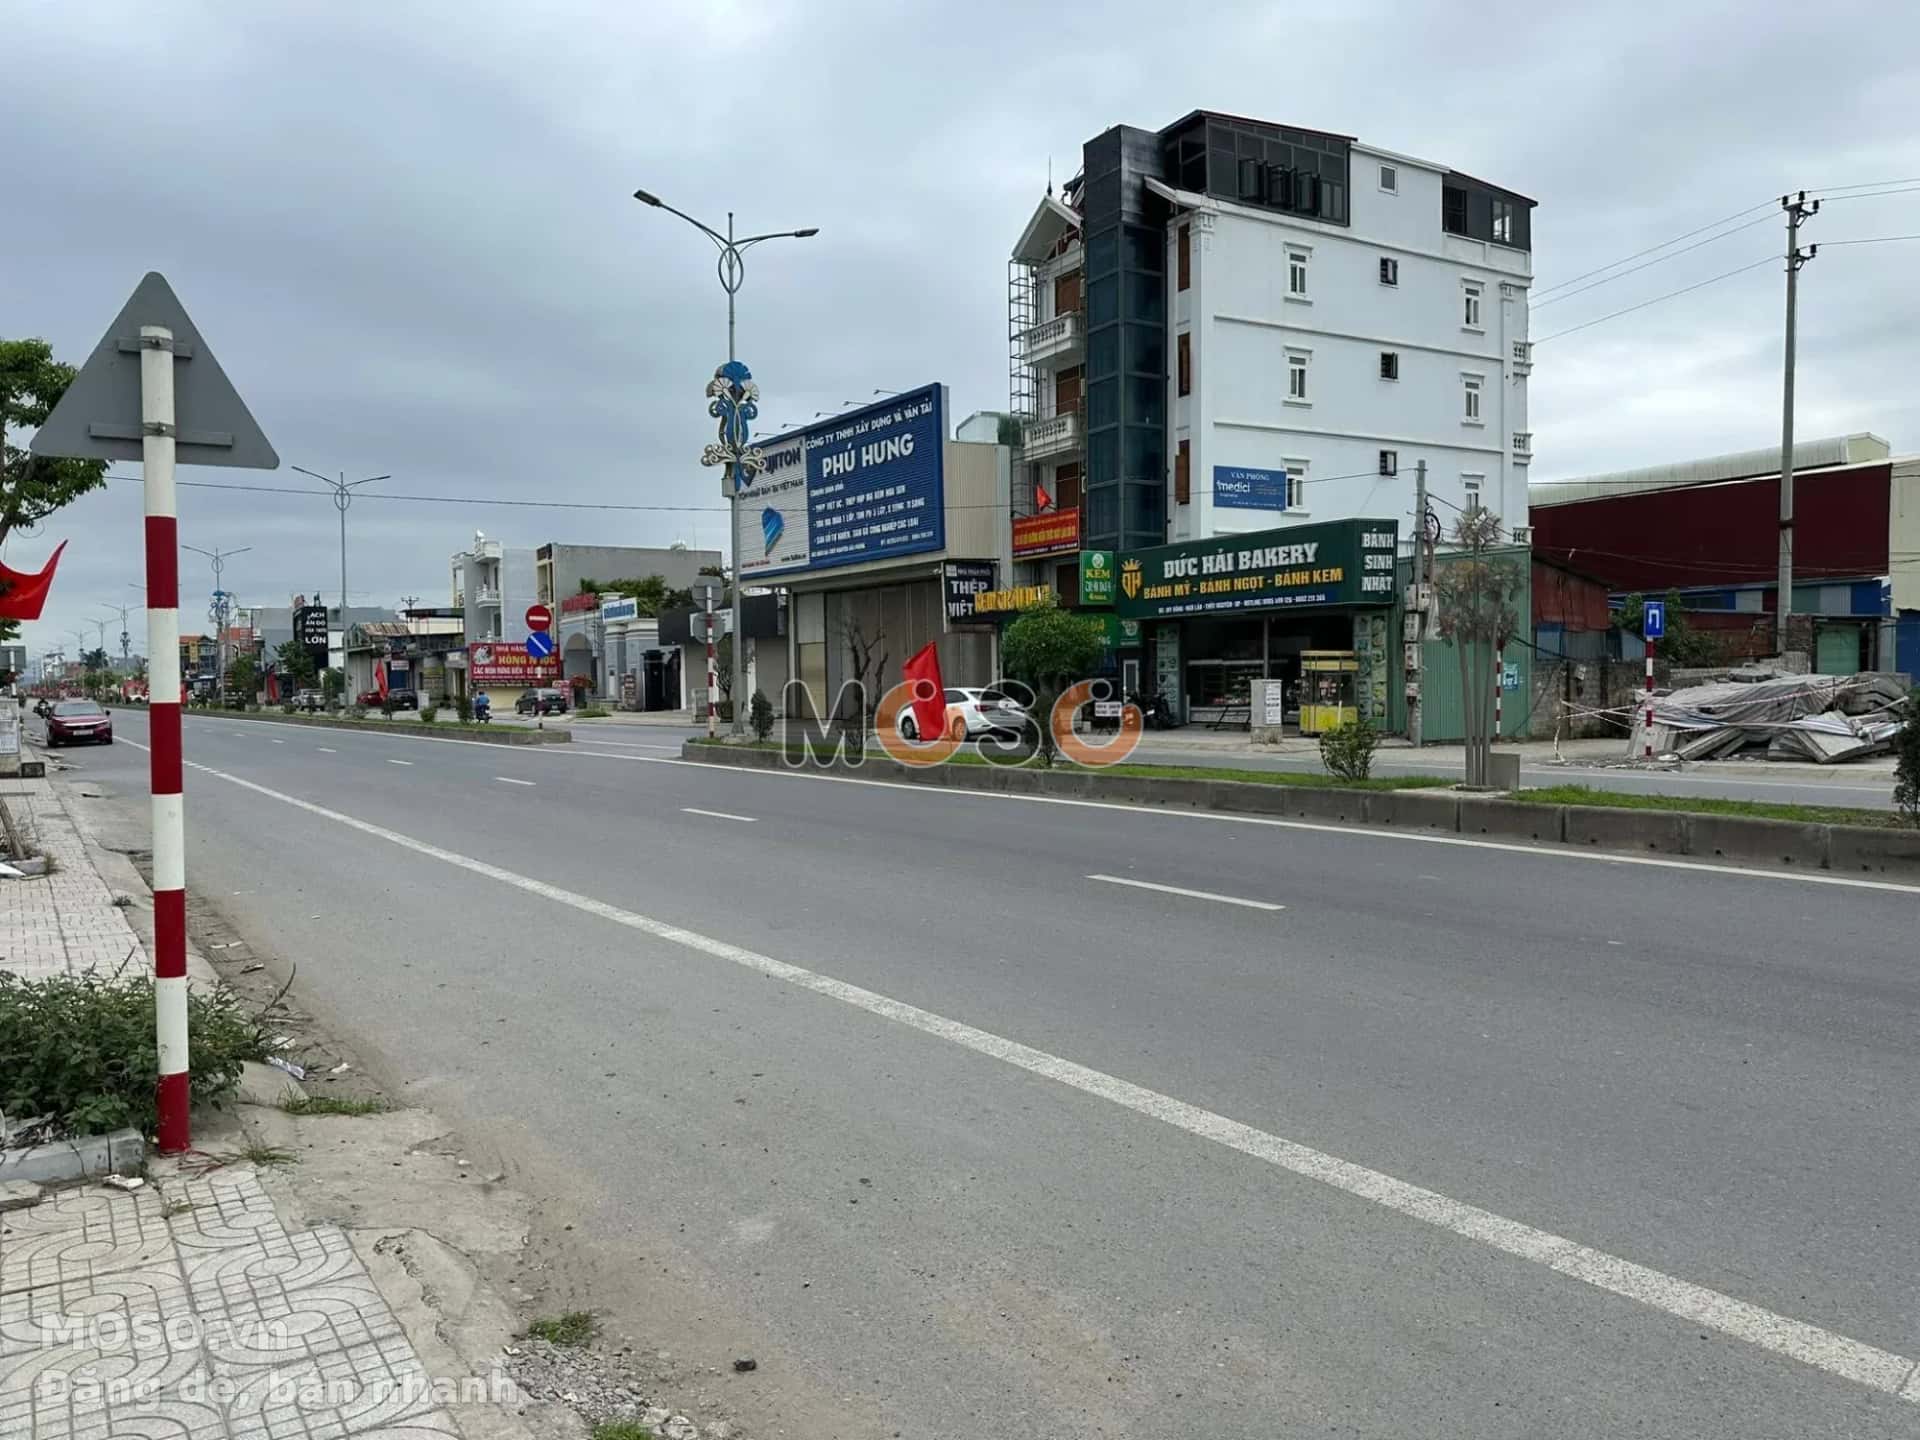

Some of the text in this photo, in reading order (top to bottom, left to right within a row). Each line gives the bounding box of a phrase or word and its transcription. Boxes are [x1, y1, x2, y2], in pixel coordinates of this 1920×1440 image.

[806, 398, 933, 450] CÔNG TY TNHH XÂY DỰNG VÀ VẬN TẢI
[758, 447, 801, 474] UJITON
[822, 433, 914, 478] PHÚ HƯNG
[1361, 528, 1394, 548] BÁNH
[1163, 542, 1319, 579] ĐỨC HẢI BAKERY
[1364, 555, 1393, 569] SINH
[1086, 569, 1110, 578] KEM
[1144, 584, 1171, 599] BÁNH
[1200, 578, 1230, 594] BÁNH
[1233, 575, 1264, 592] NGỌT
[1274, 570, 1309, 587] BÁNH
[1312, 568, 1343, 583] KEM
[1361, 572, 1393, 594] NHẬT
[950, 578, 988, 594] THÉP
